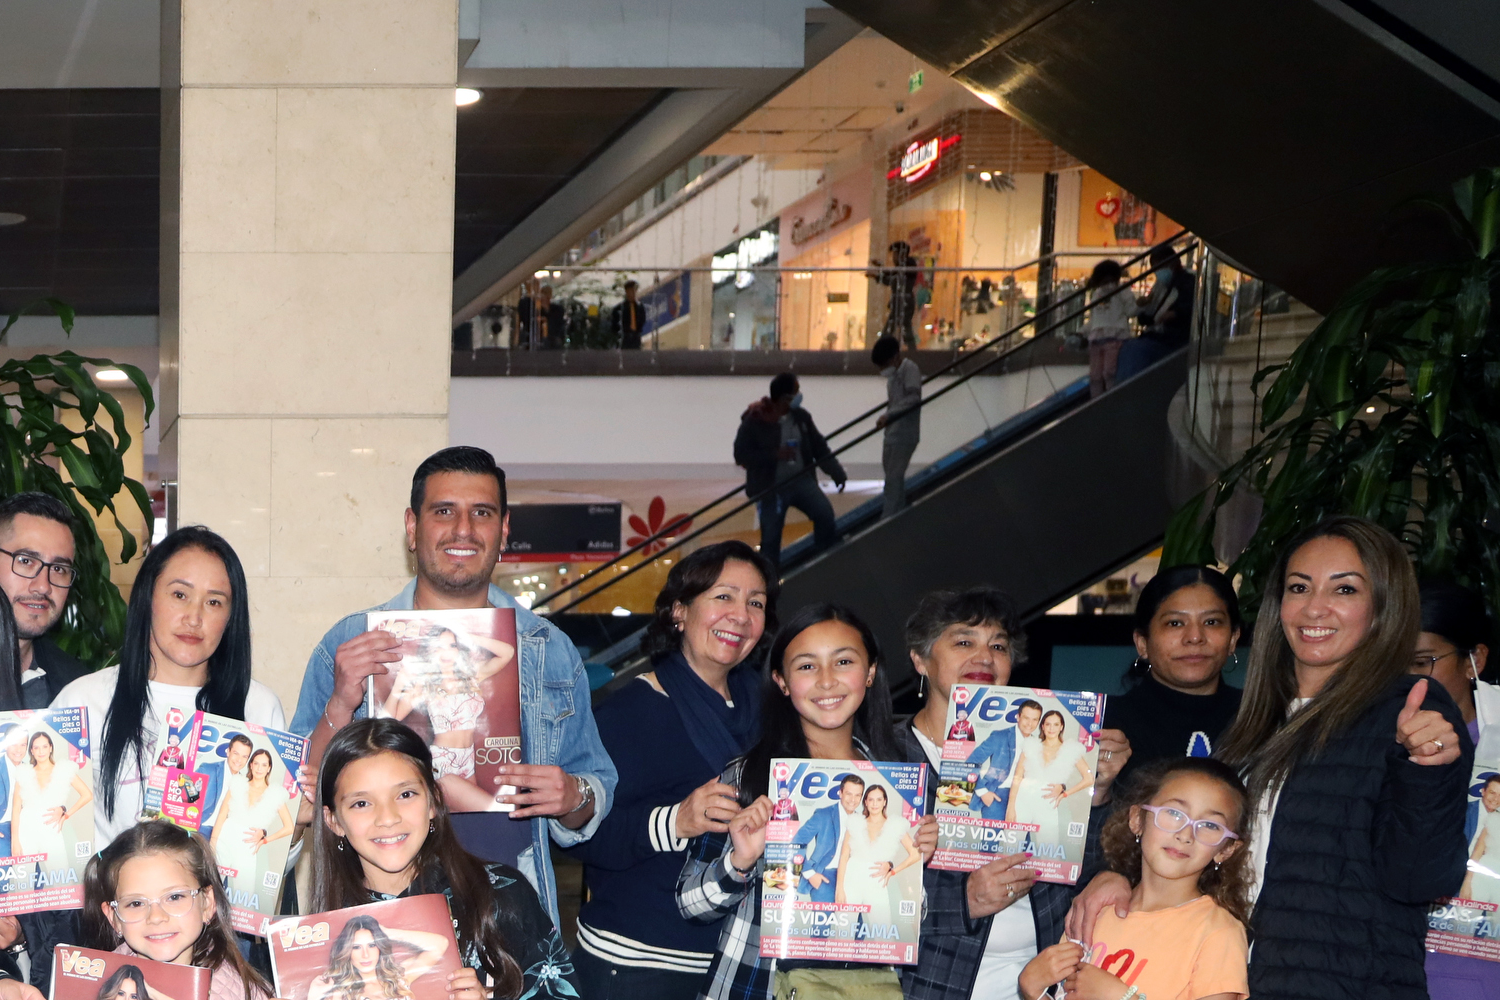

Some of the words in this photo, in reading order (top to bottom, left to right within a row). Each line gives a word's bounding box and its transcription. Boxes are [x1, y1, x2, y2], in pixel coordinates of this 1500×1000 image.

[956, 686, 1036, 723] Vea
[486, 738, 518, 746] CAROLINA
[476, 747, 521, 764] SOTO
[776, 762, 857, 800] Vea
[167, 794, 184, 803] SEA
[958, 817, 983, 826] Acuña
[992, 820, 1007, 829] Iván
[1009, 823, 1036, 831] Lalinde
[938, 824, 966, 838] SUS
[970, 827, 1017, 844] VIDAS
[971, 840, 988, 851] allá
[991, 842, 1004, 852] de
[1006, 844, 1016, 853] la
[1018, 840, 1066, 860] FAMA
[0, 858, 15, 866] Iván
[17, 855, 44, 864] Lalinde
[3, 882, 15, 892] de
[18, 881, 26, 890] la
[29, 868, 78, 888] FAMA
[225, 886, 259, 910] AMA
[1463, 900, 1494, 911] Lalinde
[840, 904, 868, 912] Lalinde
[800, 911, 849, 926] VIDAS
[1440, 920, 1454, 930] de
[280, 922, 330, 948] Vea
[802, 926, 820, 936] allá
[823, 927, 835, 936] de
[839, 928, 848, 938] la
[850, 923, 900, 940] FAMA
[60, 949, 106, 978] Vea
